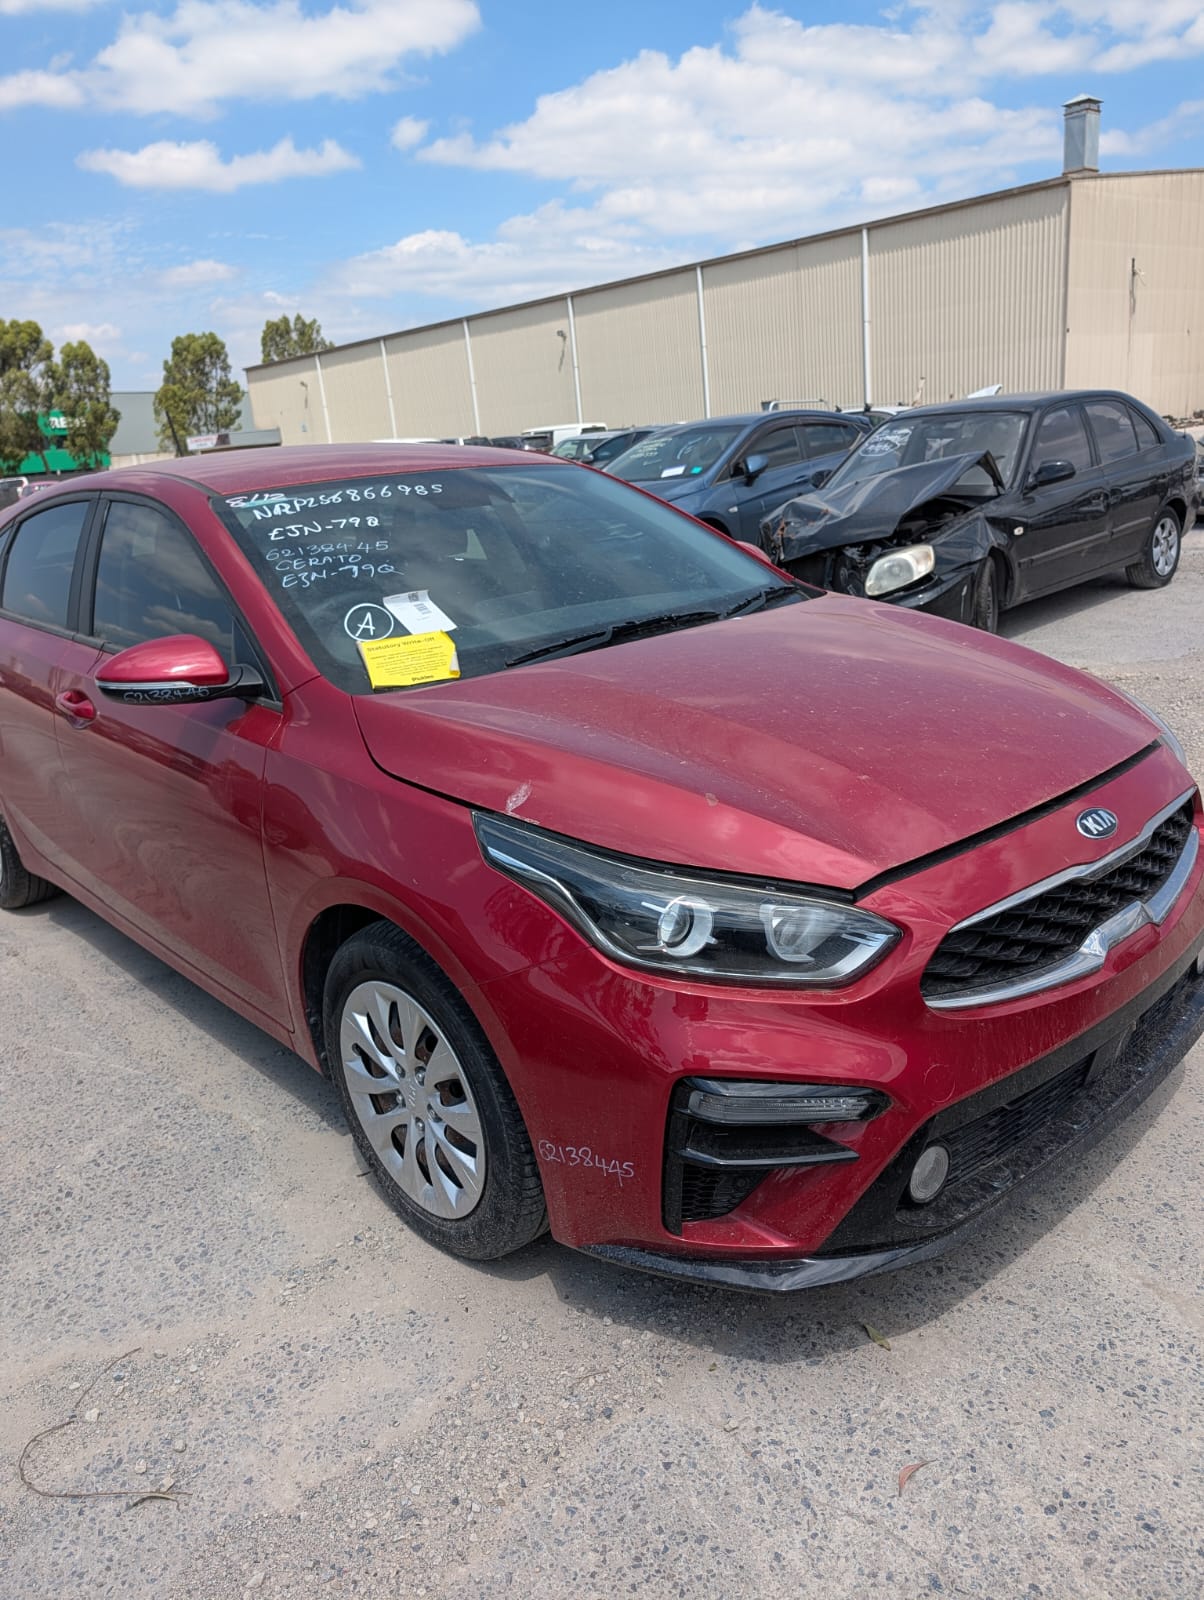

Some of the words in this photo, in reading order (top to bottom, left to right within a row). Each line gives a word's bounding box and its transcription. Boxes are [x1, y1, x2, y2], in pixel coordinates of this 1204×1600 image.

[275, 554, 362, 571] CERATO
[355, 611, 376, 637] A
[1080, 810, 1116, 835] KIA
[538, 1139, 634, 1187] 62138445
